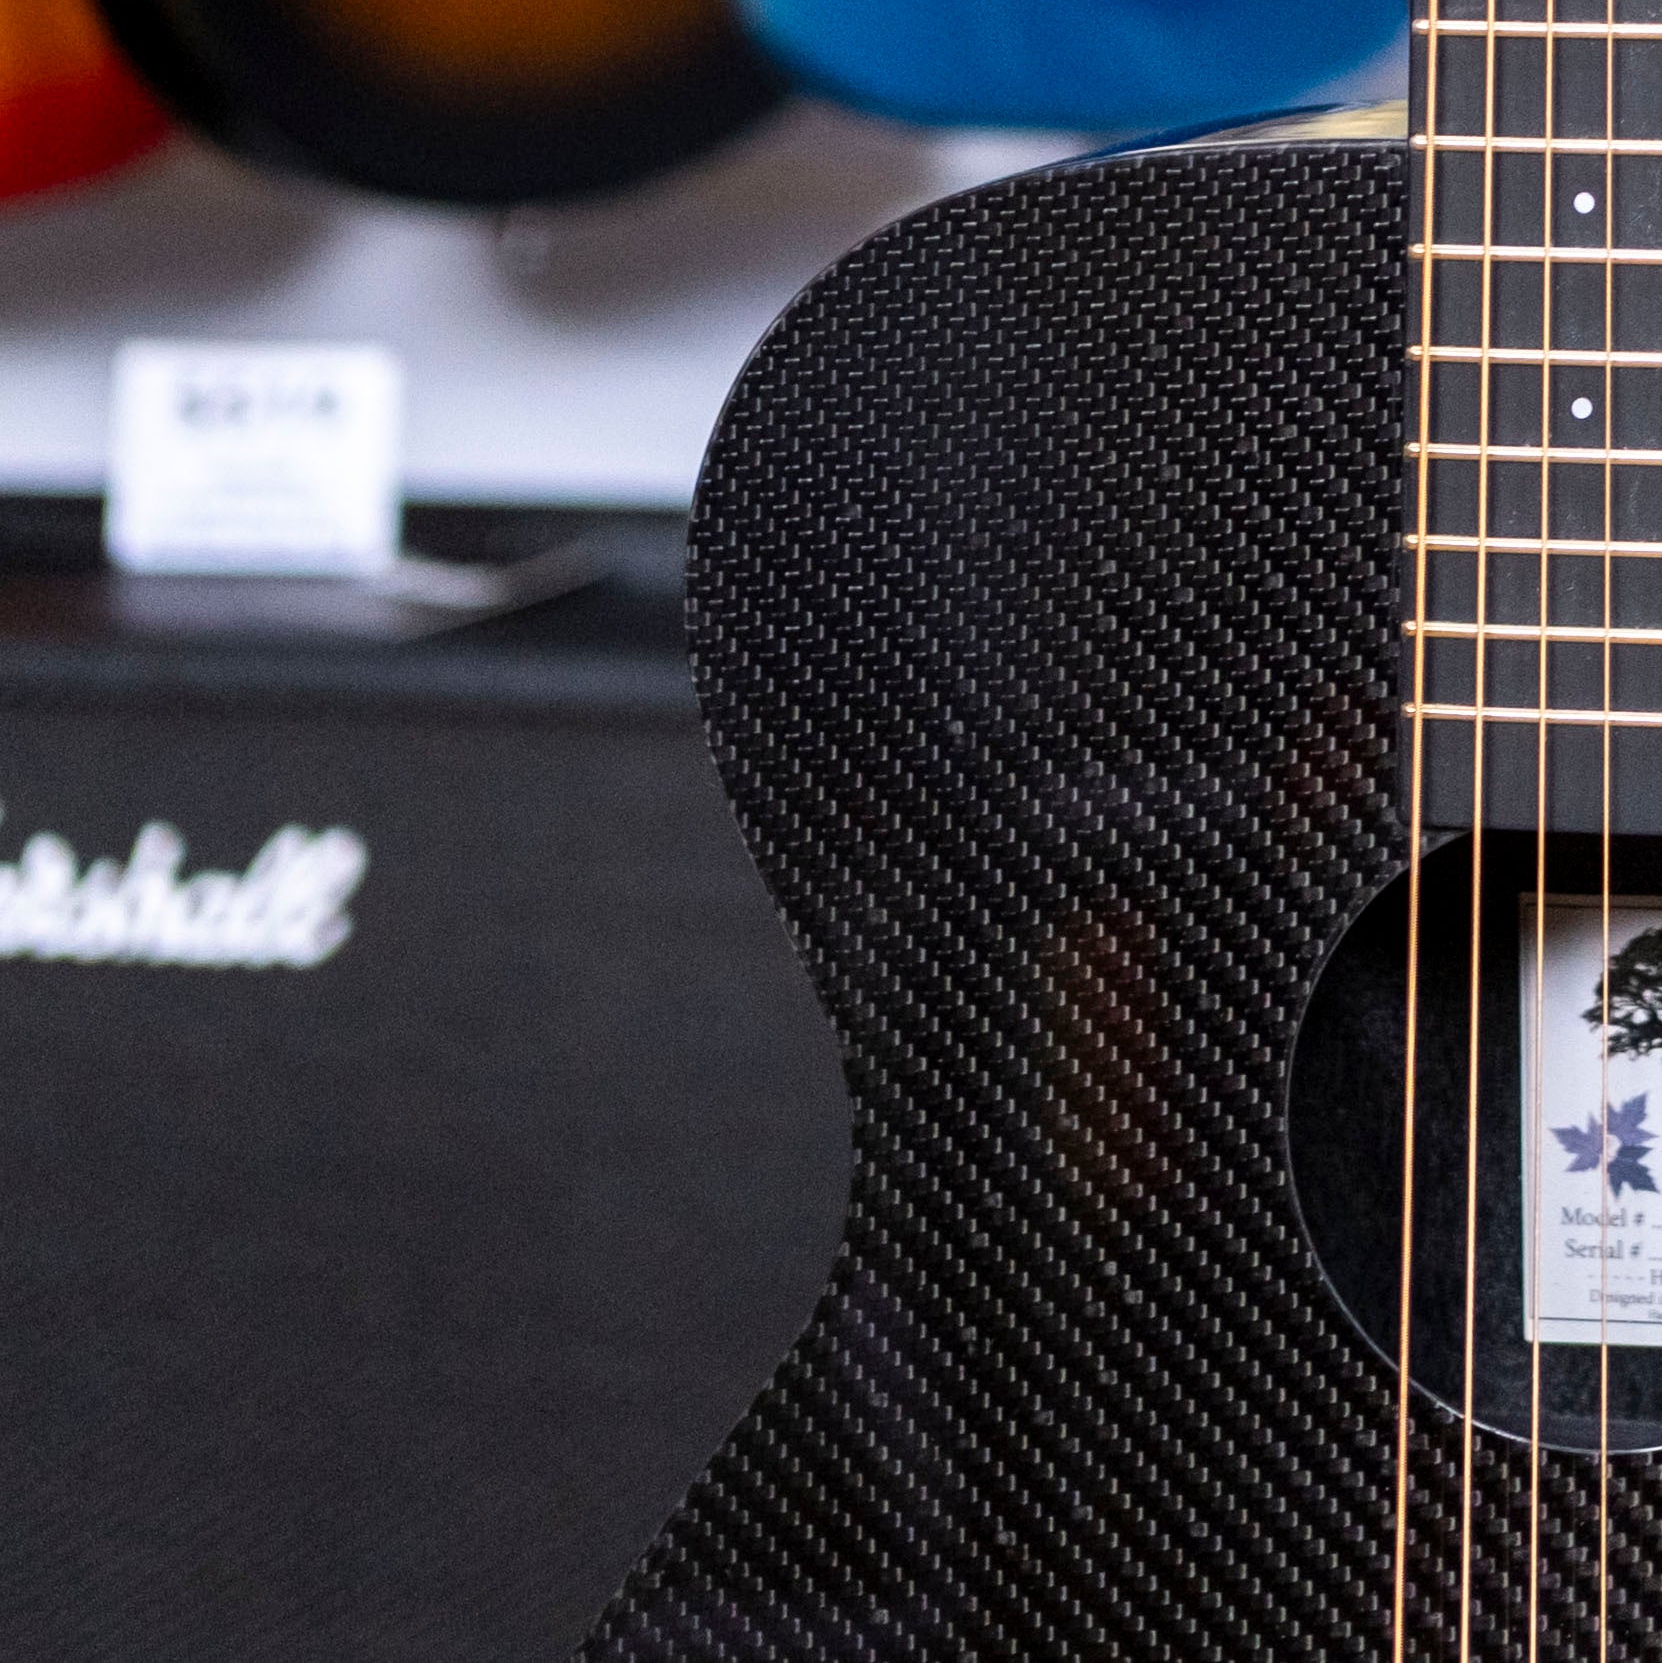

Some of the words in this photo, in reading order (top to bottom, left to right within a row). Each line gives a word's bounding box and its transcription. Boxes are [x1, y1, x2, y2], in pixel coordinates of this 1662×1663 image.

[1560, 1207, 1626, 1227] Model
[1632, 1210, 1645, 1227] #
[1565, 1238, 1623, 1259] Serial
